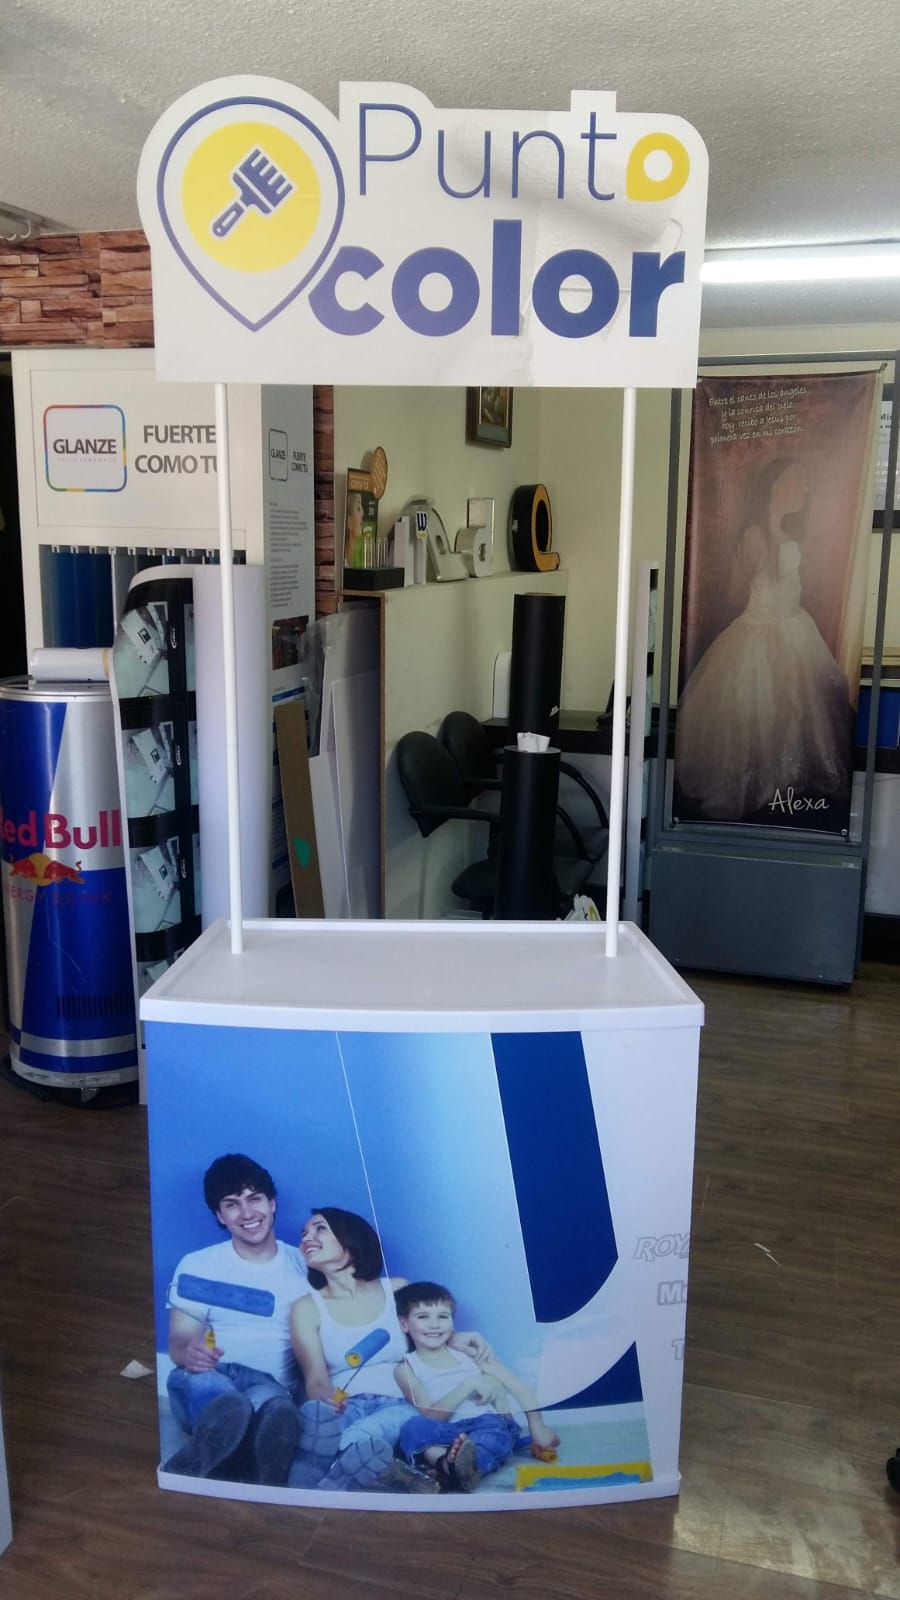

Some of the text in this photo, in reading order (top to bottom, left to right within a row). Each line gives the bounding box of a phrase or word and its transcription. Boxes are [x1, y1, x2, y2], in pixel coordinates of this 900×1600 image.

[358, 102, 691, 201] Punto
[307, 218, 686, 339] color
[53, 438, 118, 455] GLANZE
[143, 424, 217, 443] FUERTE
[134, 454, 199, 474] COMO
[768, 786, 830, 815] Alexa
[0, 803, 121, 850] ed Bull
